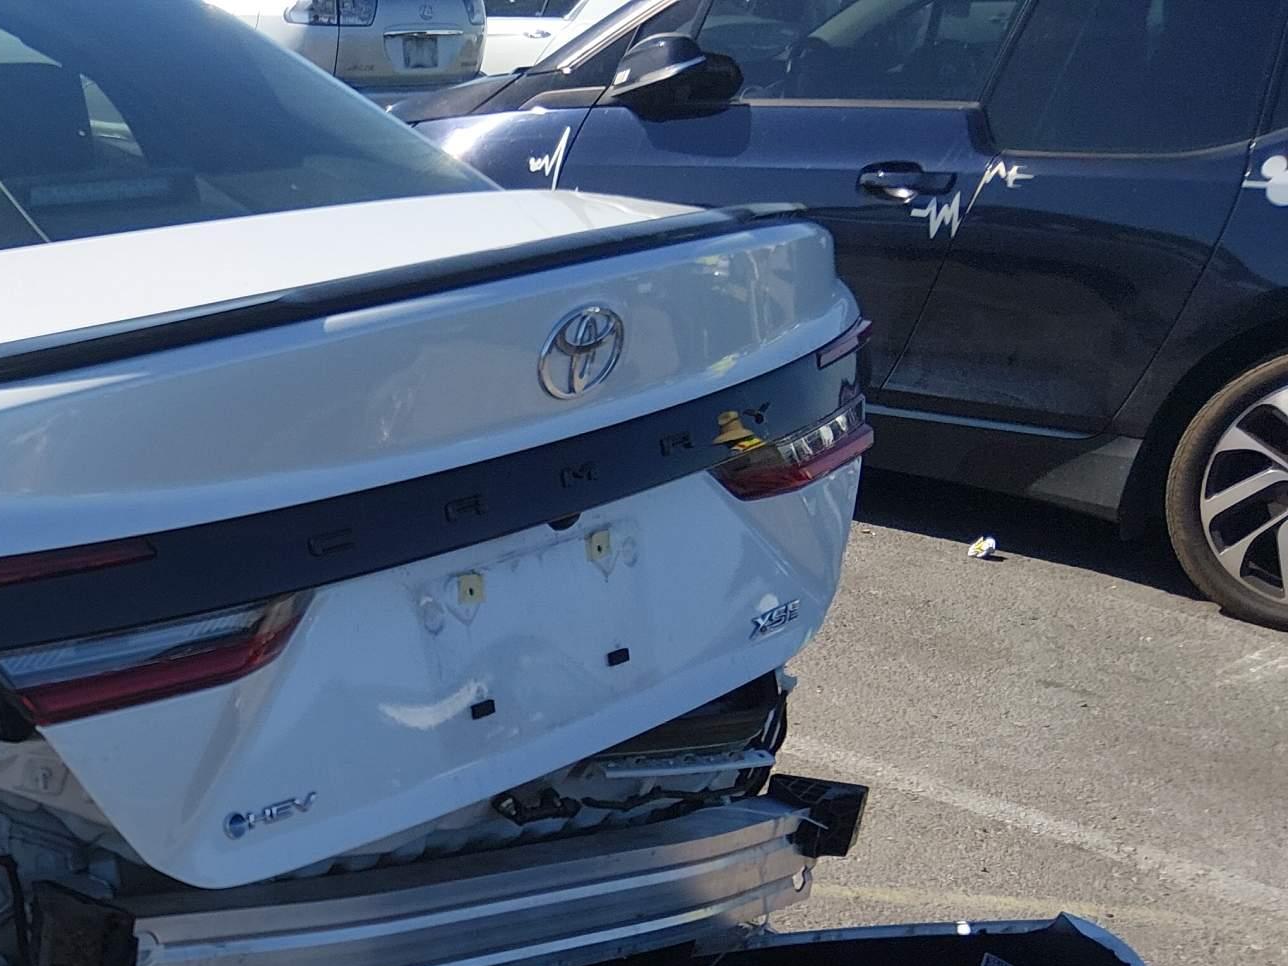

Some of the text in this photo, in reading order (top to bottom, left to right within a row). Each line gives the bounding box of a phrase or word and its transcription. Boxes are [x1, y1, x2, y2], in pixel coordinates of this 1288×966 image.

[307, 401, 770, 558] CAMRY
[750, 599, 800, 640] XSE
[246, 791, 317, 830] HEV
